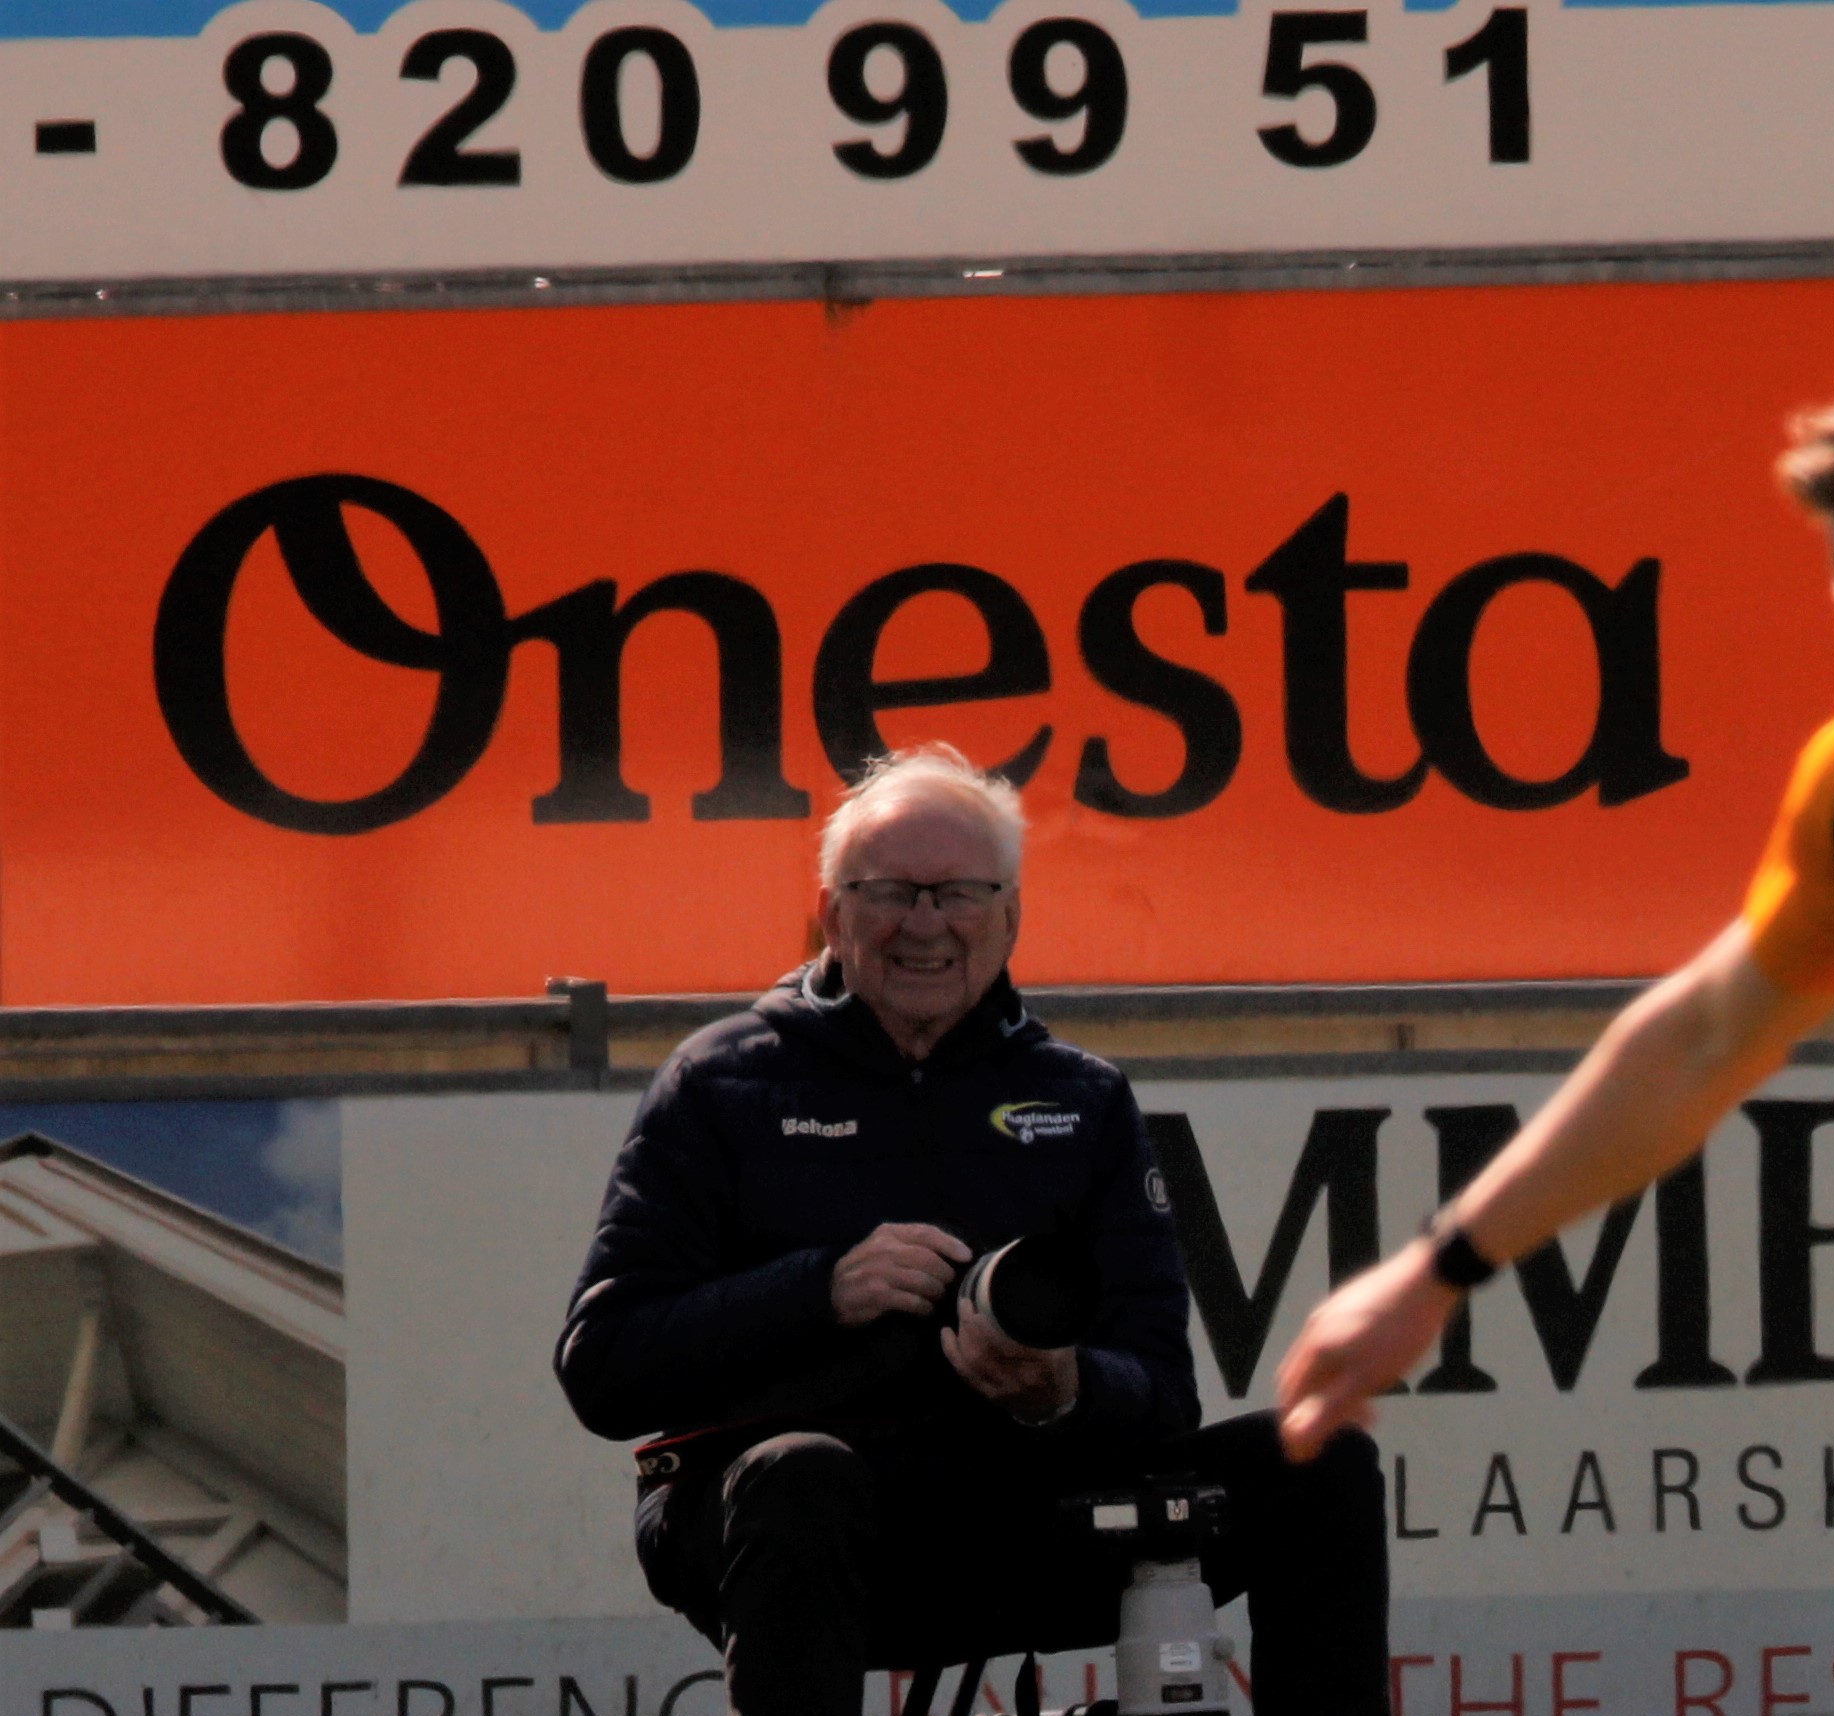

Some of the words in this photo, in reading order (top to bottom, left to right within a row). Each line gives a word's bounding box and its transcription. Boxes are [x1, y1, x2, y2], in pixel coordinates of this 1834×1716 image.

[219, 25, 702, 192] 820
[826, 17, 1130, 180] 99
[1257, 8, 1531, 169] 51
[153, 472, 1690, 836] Onesta
